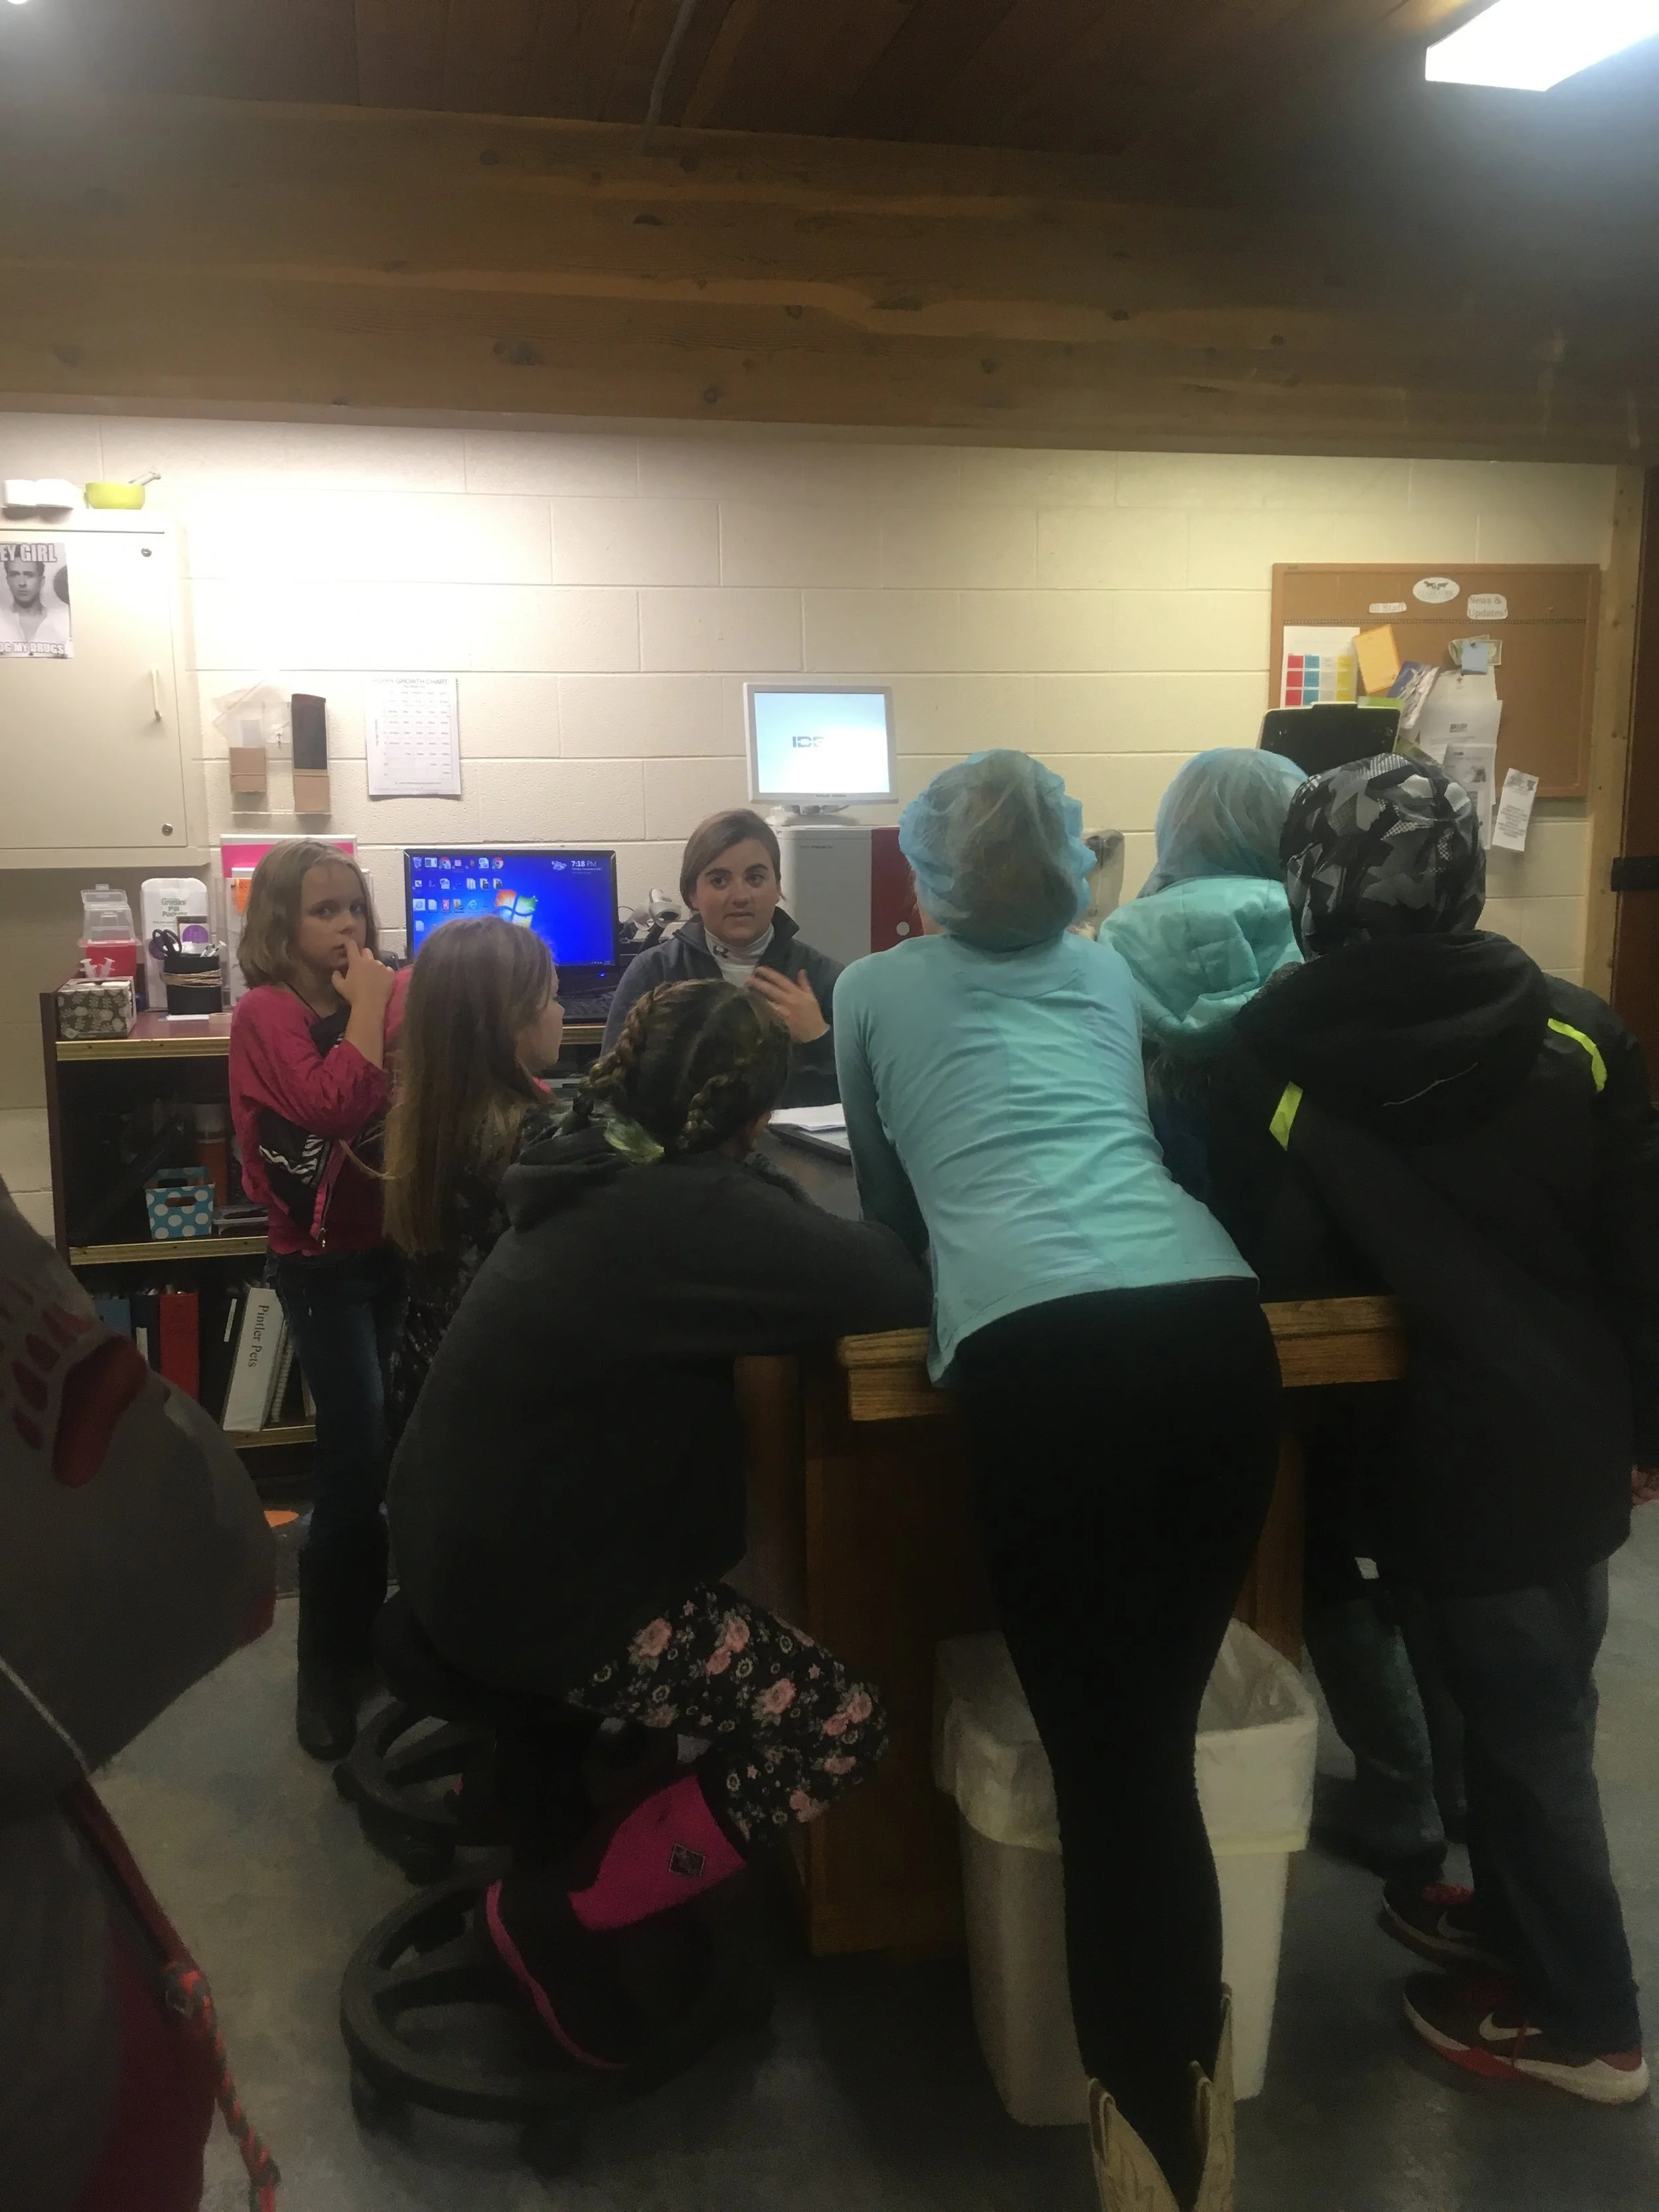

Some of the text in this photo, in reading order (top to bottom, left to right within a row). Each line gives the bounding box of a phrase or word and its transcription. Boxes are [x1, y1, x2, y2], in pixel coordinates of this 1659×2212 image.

[20, 543, 58, 562] GIRL
[1494, 595, 1502, 605] &
[1380, 603, 1406, 612] Staff
[1468, 607, 1507, 619] Updates!
[13, 642, 29, 653] MY
[29, 642, 65, 654] DRUGS
[248, 1304, 269, 1368] Pintler Pets
